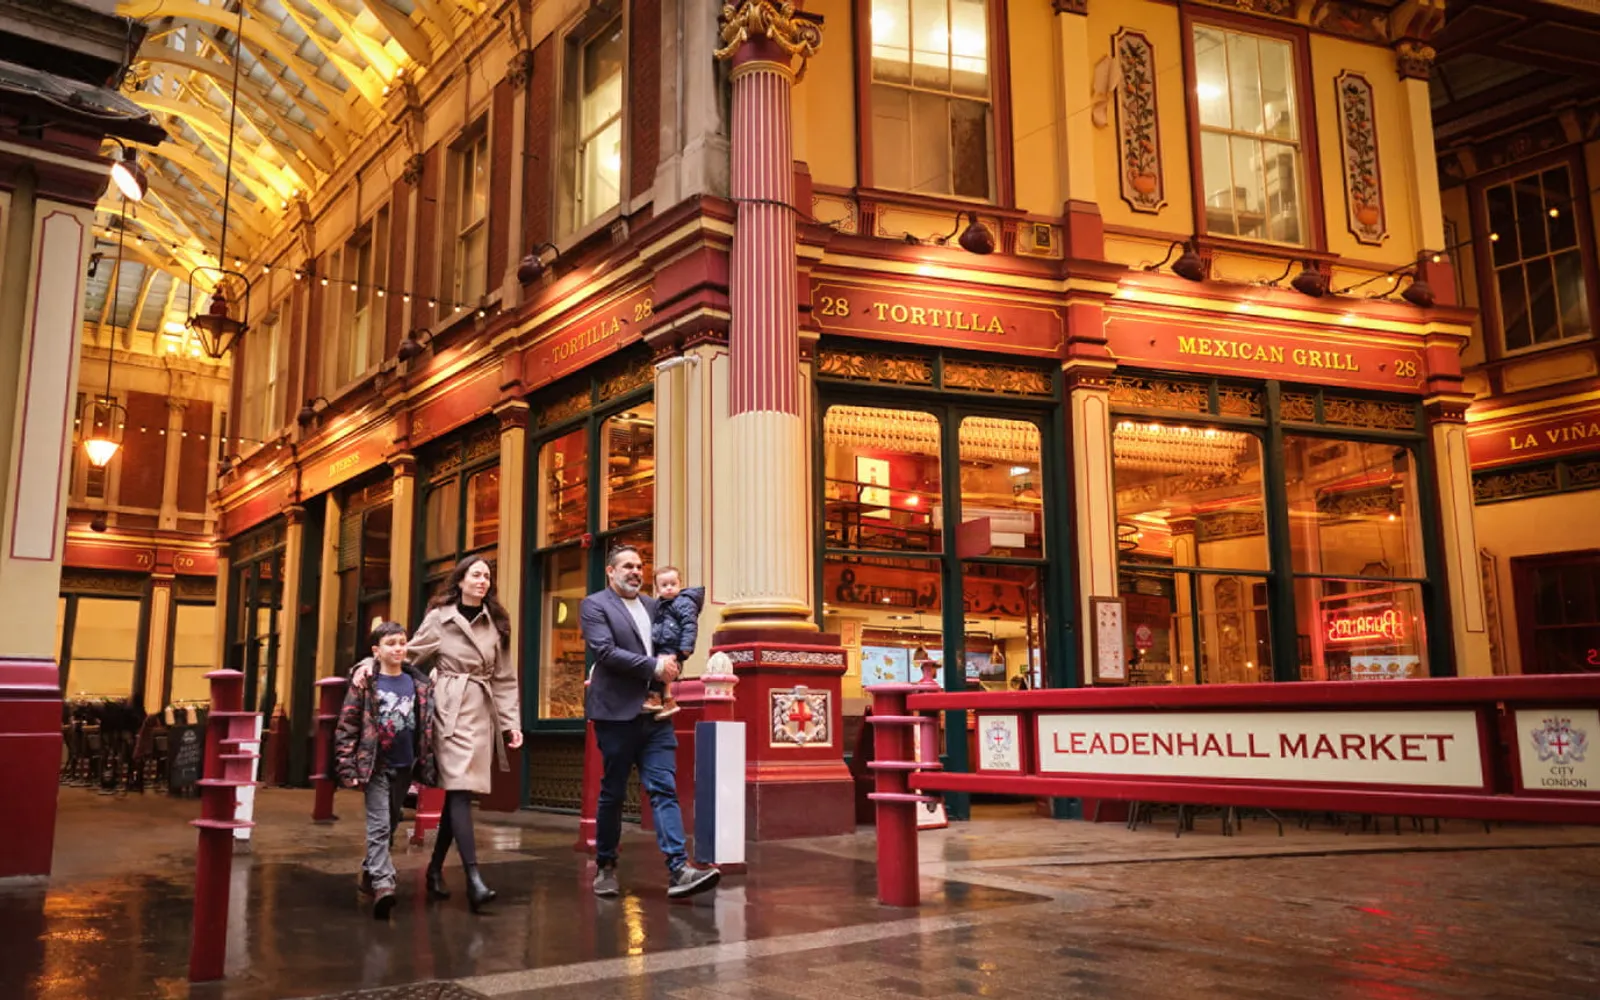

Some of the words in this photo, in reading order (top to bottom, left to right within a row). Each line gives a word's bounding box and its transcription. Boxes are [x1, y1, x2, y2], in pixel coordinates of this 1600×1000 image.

[820, 296, 850, 317] 28
[873, 302, 1005, 334] TORTILLA
[552, 315, 620, 364] TORTILLA
[634, 297, 653, 322] 28
[1177, 336, 1285, 363] MEXICAN
[1292, 349, 1360, 372] GRILL
[1394, 359, 1417, 378] 28
[1509, 433, 1539, 451] LA
[1545, 421, 1600, 444] VIÑA
[136, 554, 149, 564] 71
[178, 557, 195, 567] 70
[1052, 731, 1271, 759] LEADENHALL
[1279, 732, 1455, 762] MARKET
[1541, 778, 1588, 788] LONDON
[1549, 766, 1575, 776] CITY
